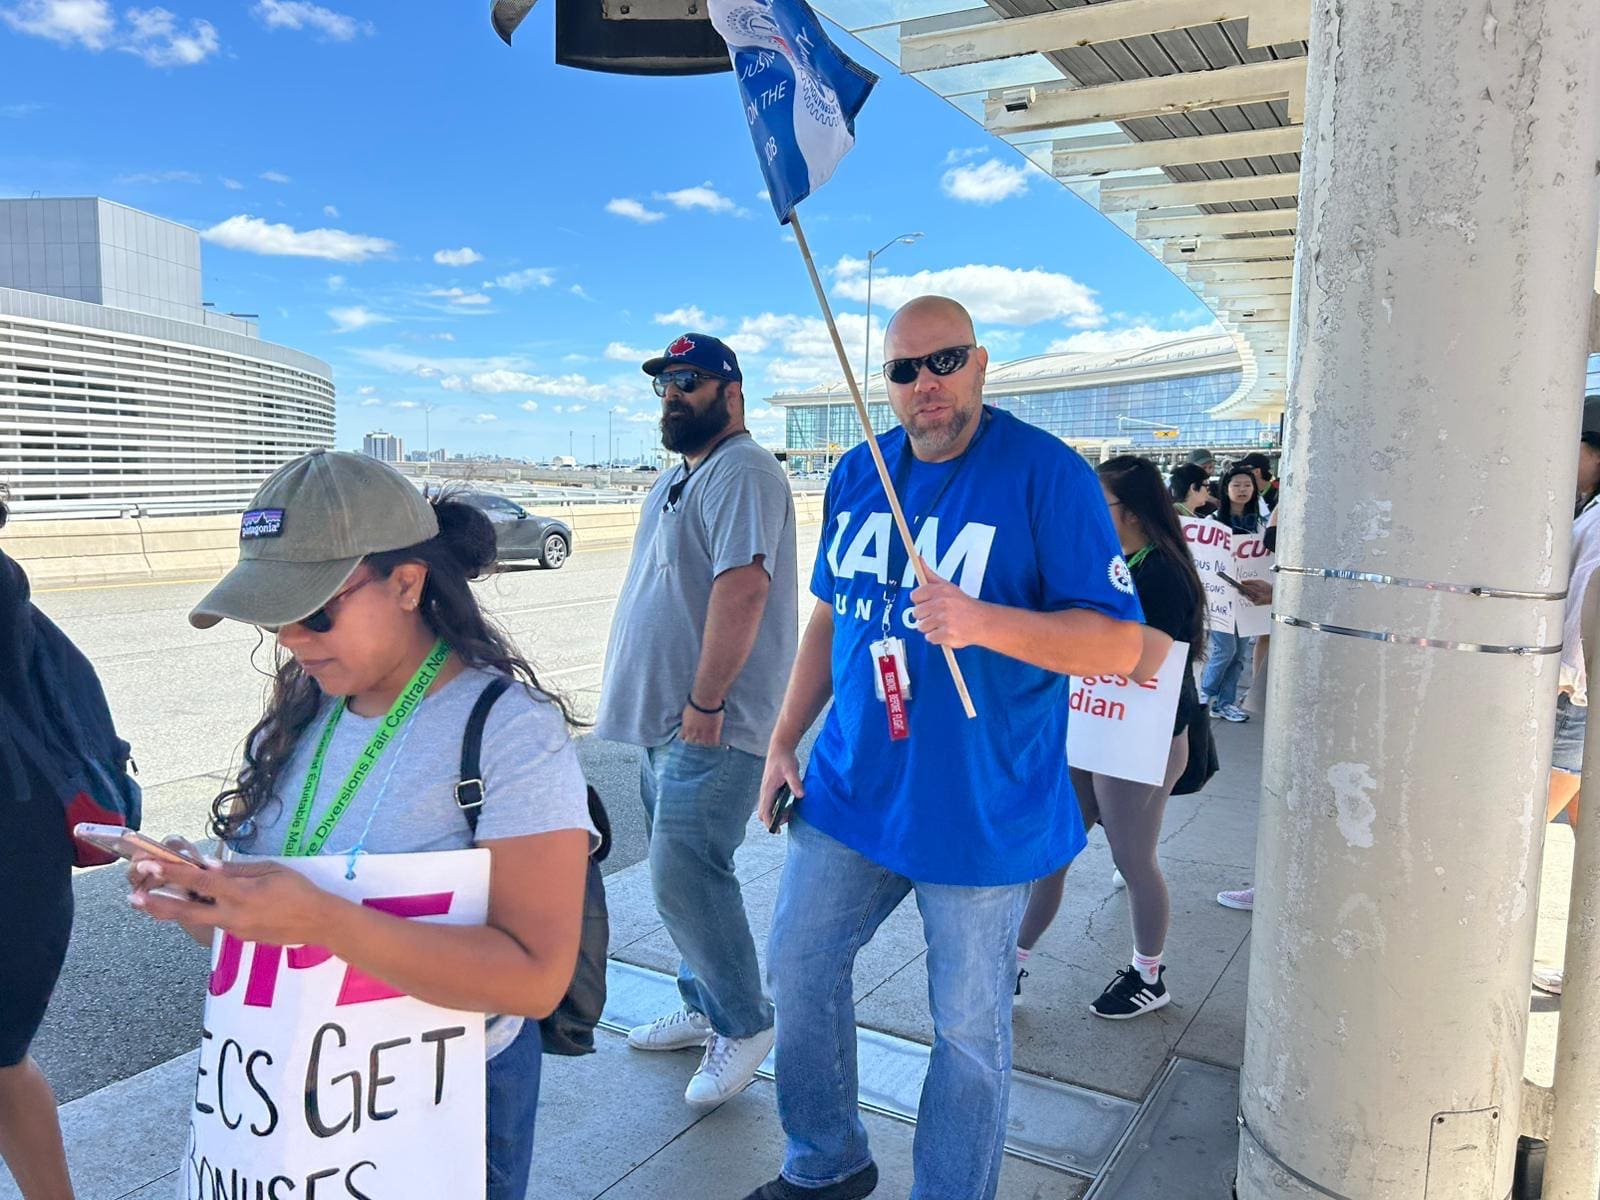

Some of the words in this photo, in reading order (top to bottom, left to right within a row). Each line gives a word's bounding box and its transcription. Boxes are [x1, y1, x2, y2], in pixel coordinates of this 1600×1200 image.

[761, 80, 788, 110] THE
[765, 136, 777, 166] JOB
[1182, 523, 1231, 551] CUPE
[1236, 540, 1271, 559] CU
[827, 511, 997, 599] IAM
[1203, 582, 1226, 595] EONS
[365, 730, 390, 760] Fair
[386, 670, 433, 728] Contract
[1069, 688, 1126, 721] dian
[195, 1027, 278, 1137] ECS
[304, 1022, 466, 1138] GET
